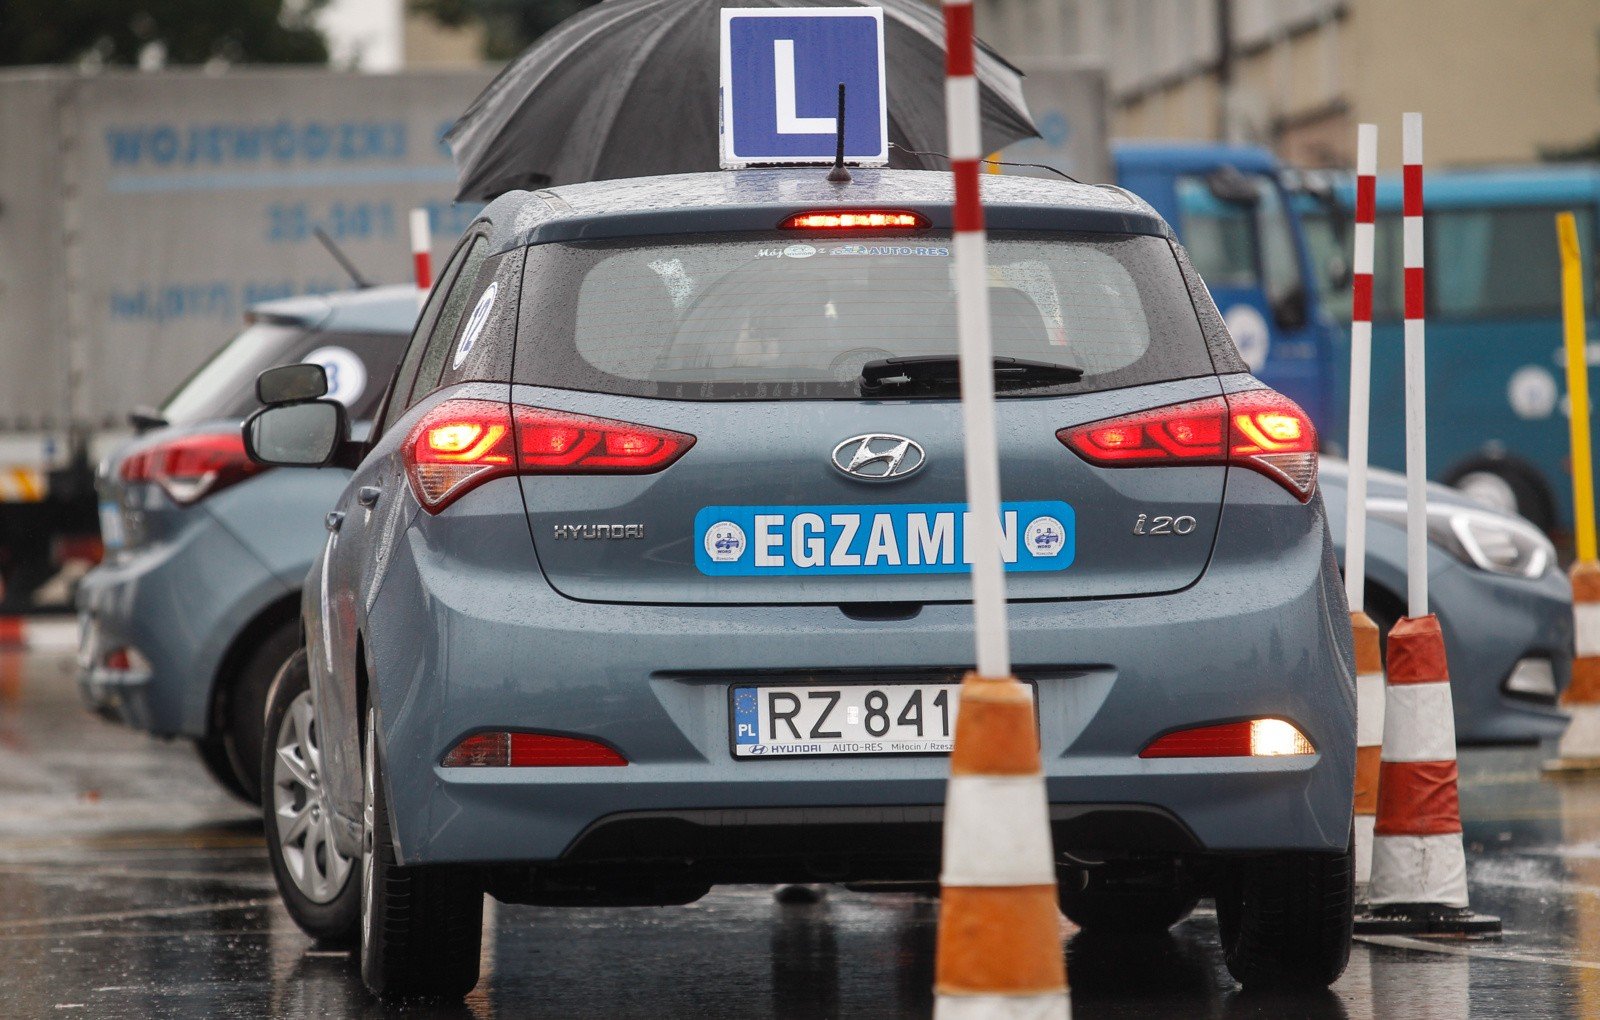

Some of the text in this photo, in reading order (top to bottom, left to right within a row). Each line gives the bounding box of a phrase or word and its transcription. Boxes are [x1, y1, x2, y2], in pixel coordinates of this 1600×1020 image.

[774, 39, 838, 134] L
[869, 246, 950, 257] AUTO-RES
[553, 524, 645, 540] HYUNDAI
[1132, 513, 1197, 537] i20
[768, 689, 950, 740] RZ 841
[738, 723, 756, 737] PL
[771, 744, 821, 754] HYUNDAI
[832, 742, 883, 753] AUTO-RES
[930, 742, 957, 751] Rzesz
